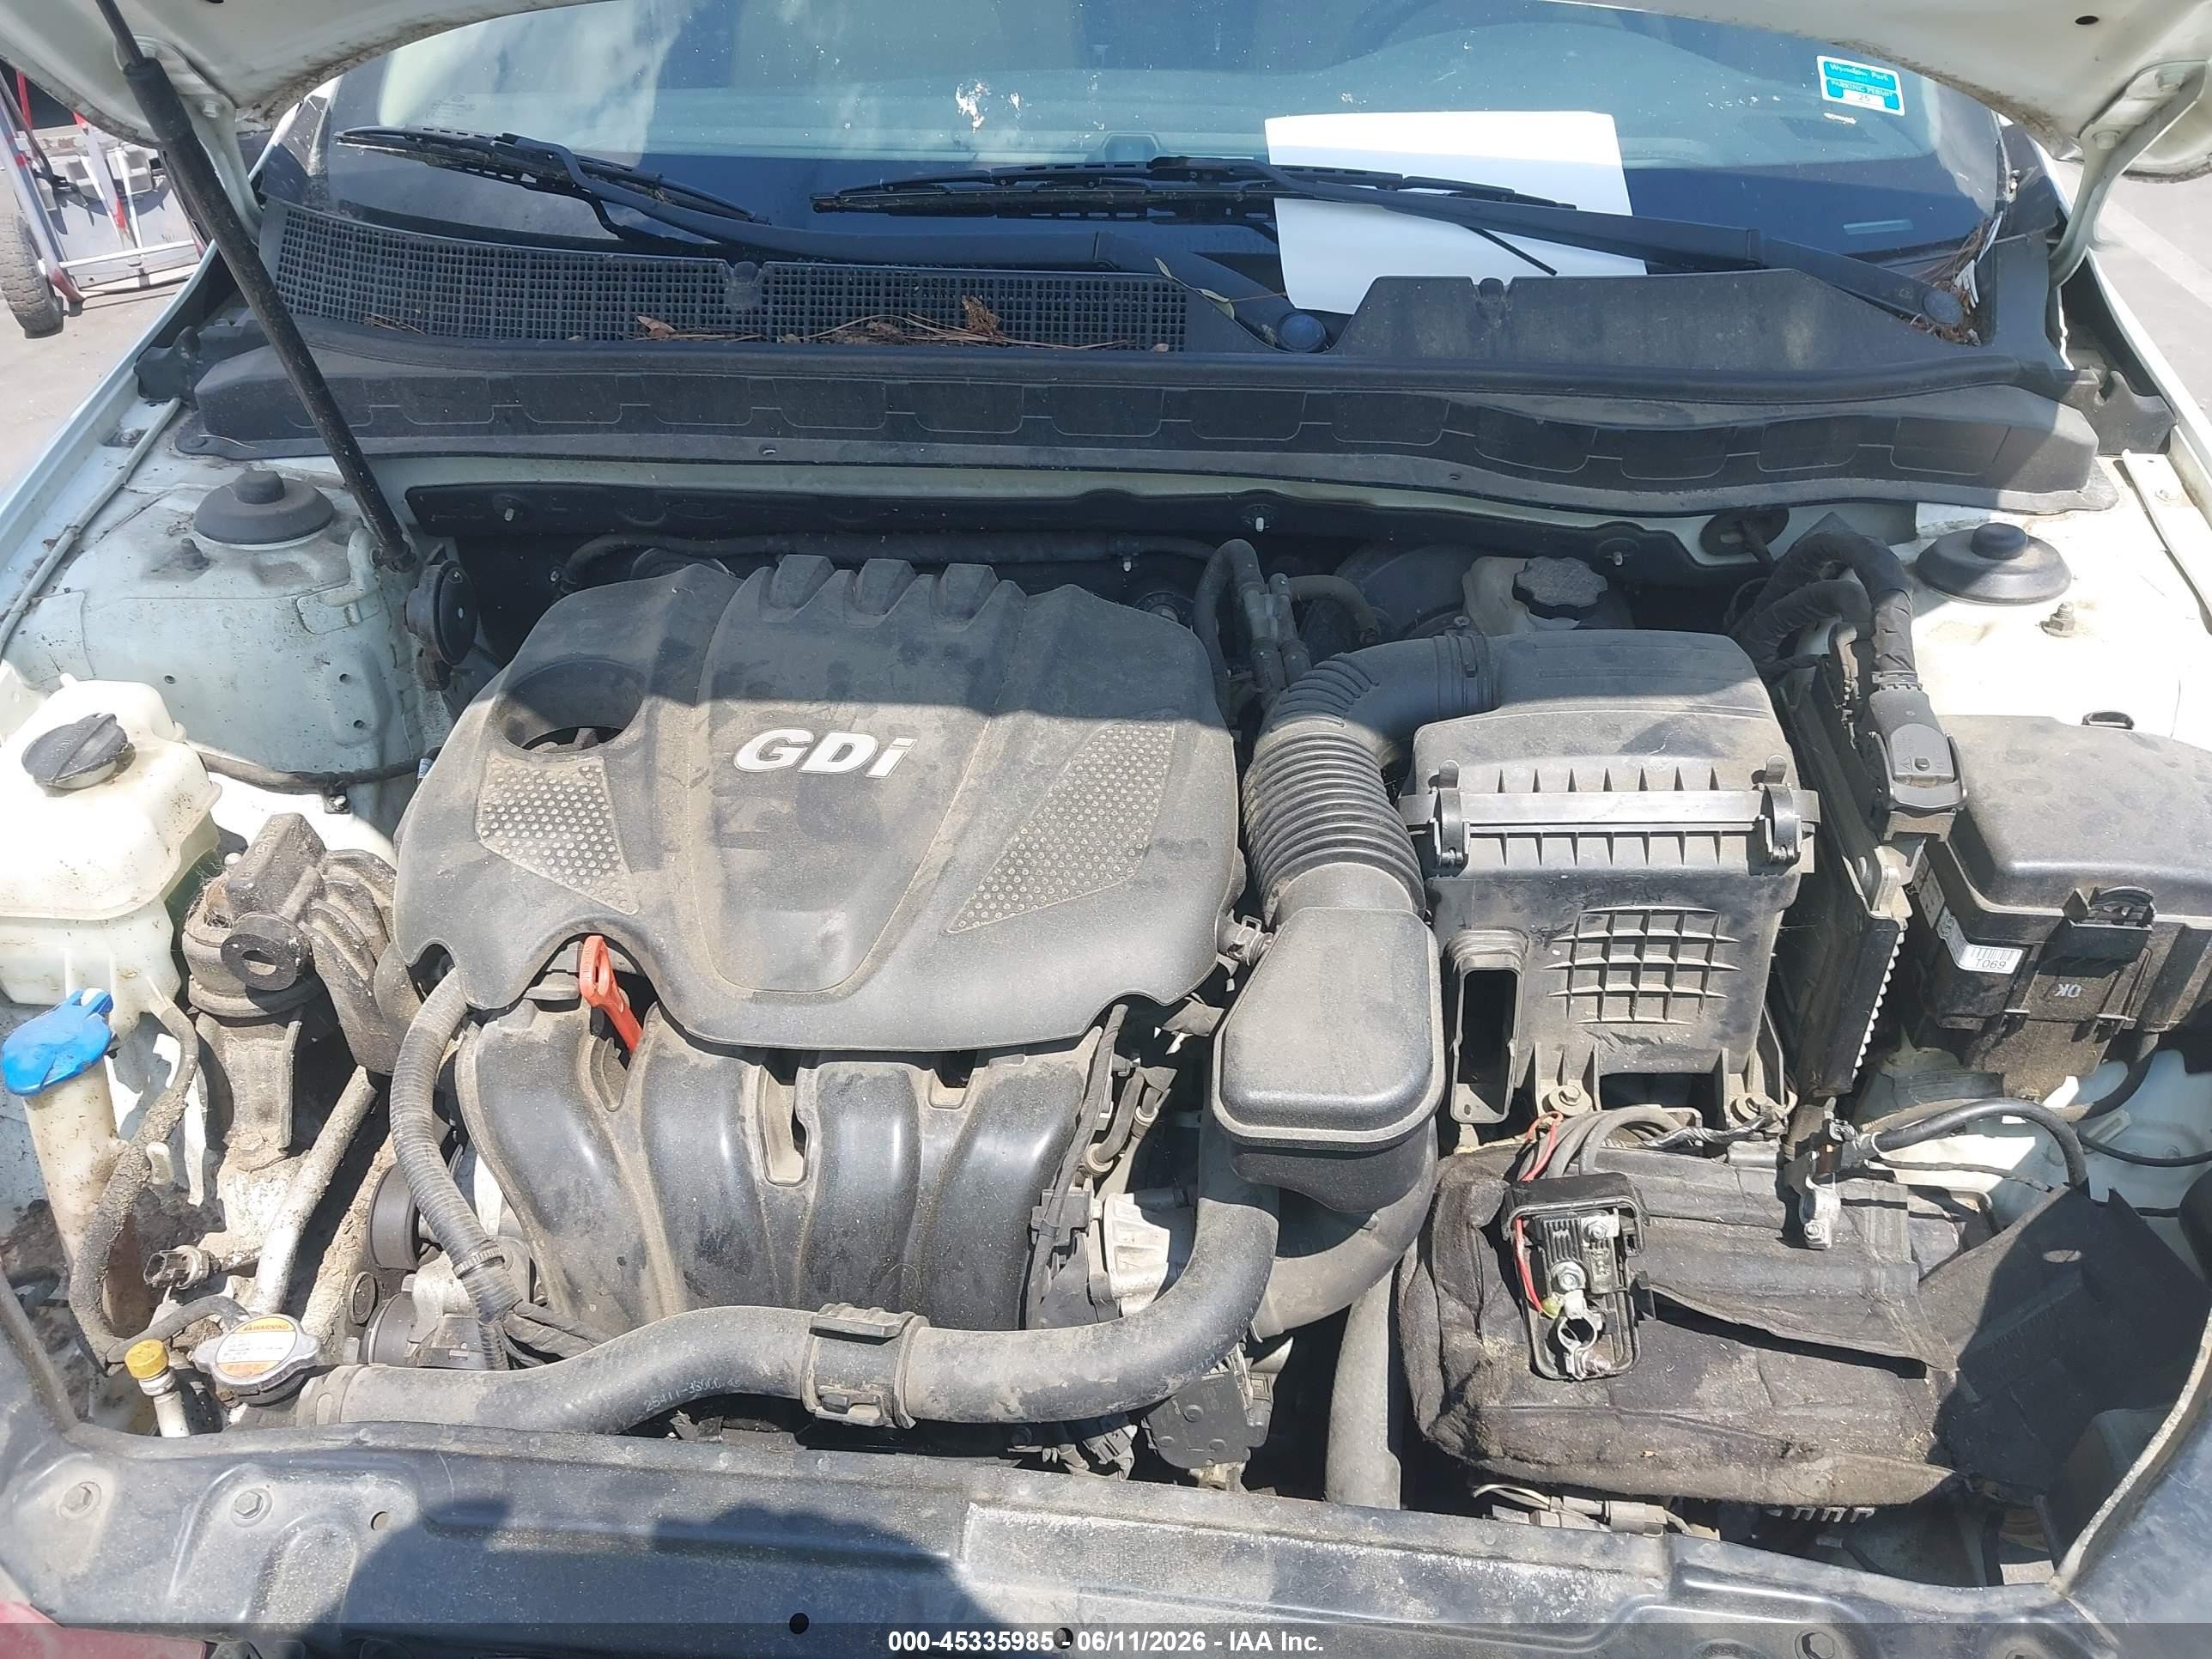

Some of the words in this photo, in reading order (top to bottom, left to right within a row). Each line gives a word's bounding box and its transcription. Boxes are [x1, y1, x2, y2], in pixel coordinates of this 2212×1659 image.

[1871, 71, 1889, 82] Park
[1830, 79, 1866, 93] PARKING
[1867, 87, 1893, 97] PERMIT
[1858, 94, 1870, 102] 25
[734, 727, 918, 778] GDi
[2054, 983, 2082, 998] OK
